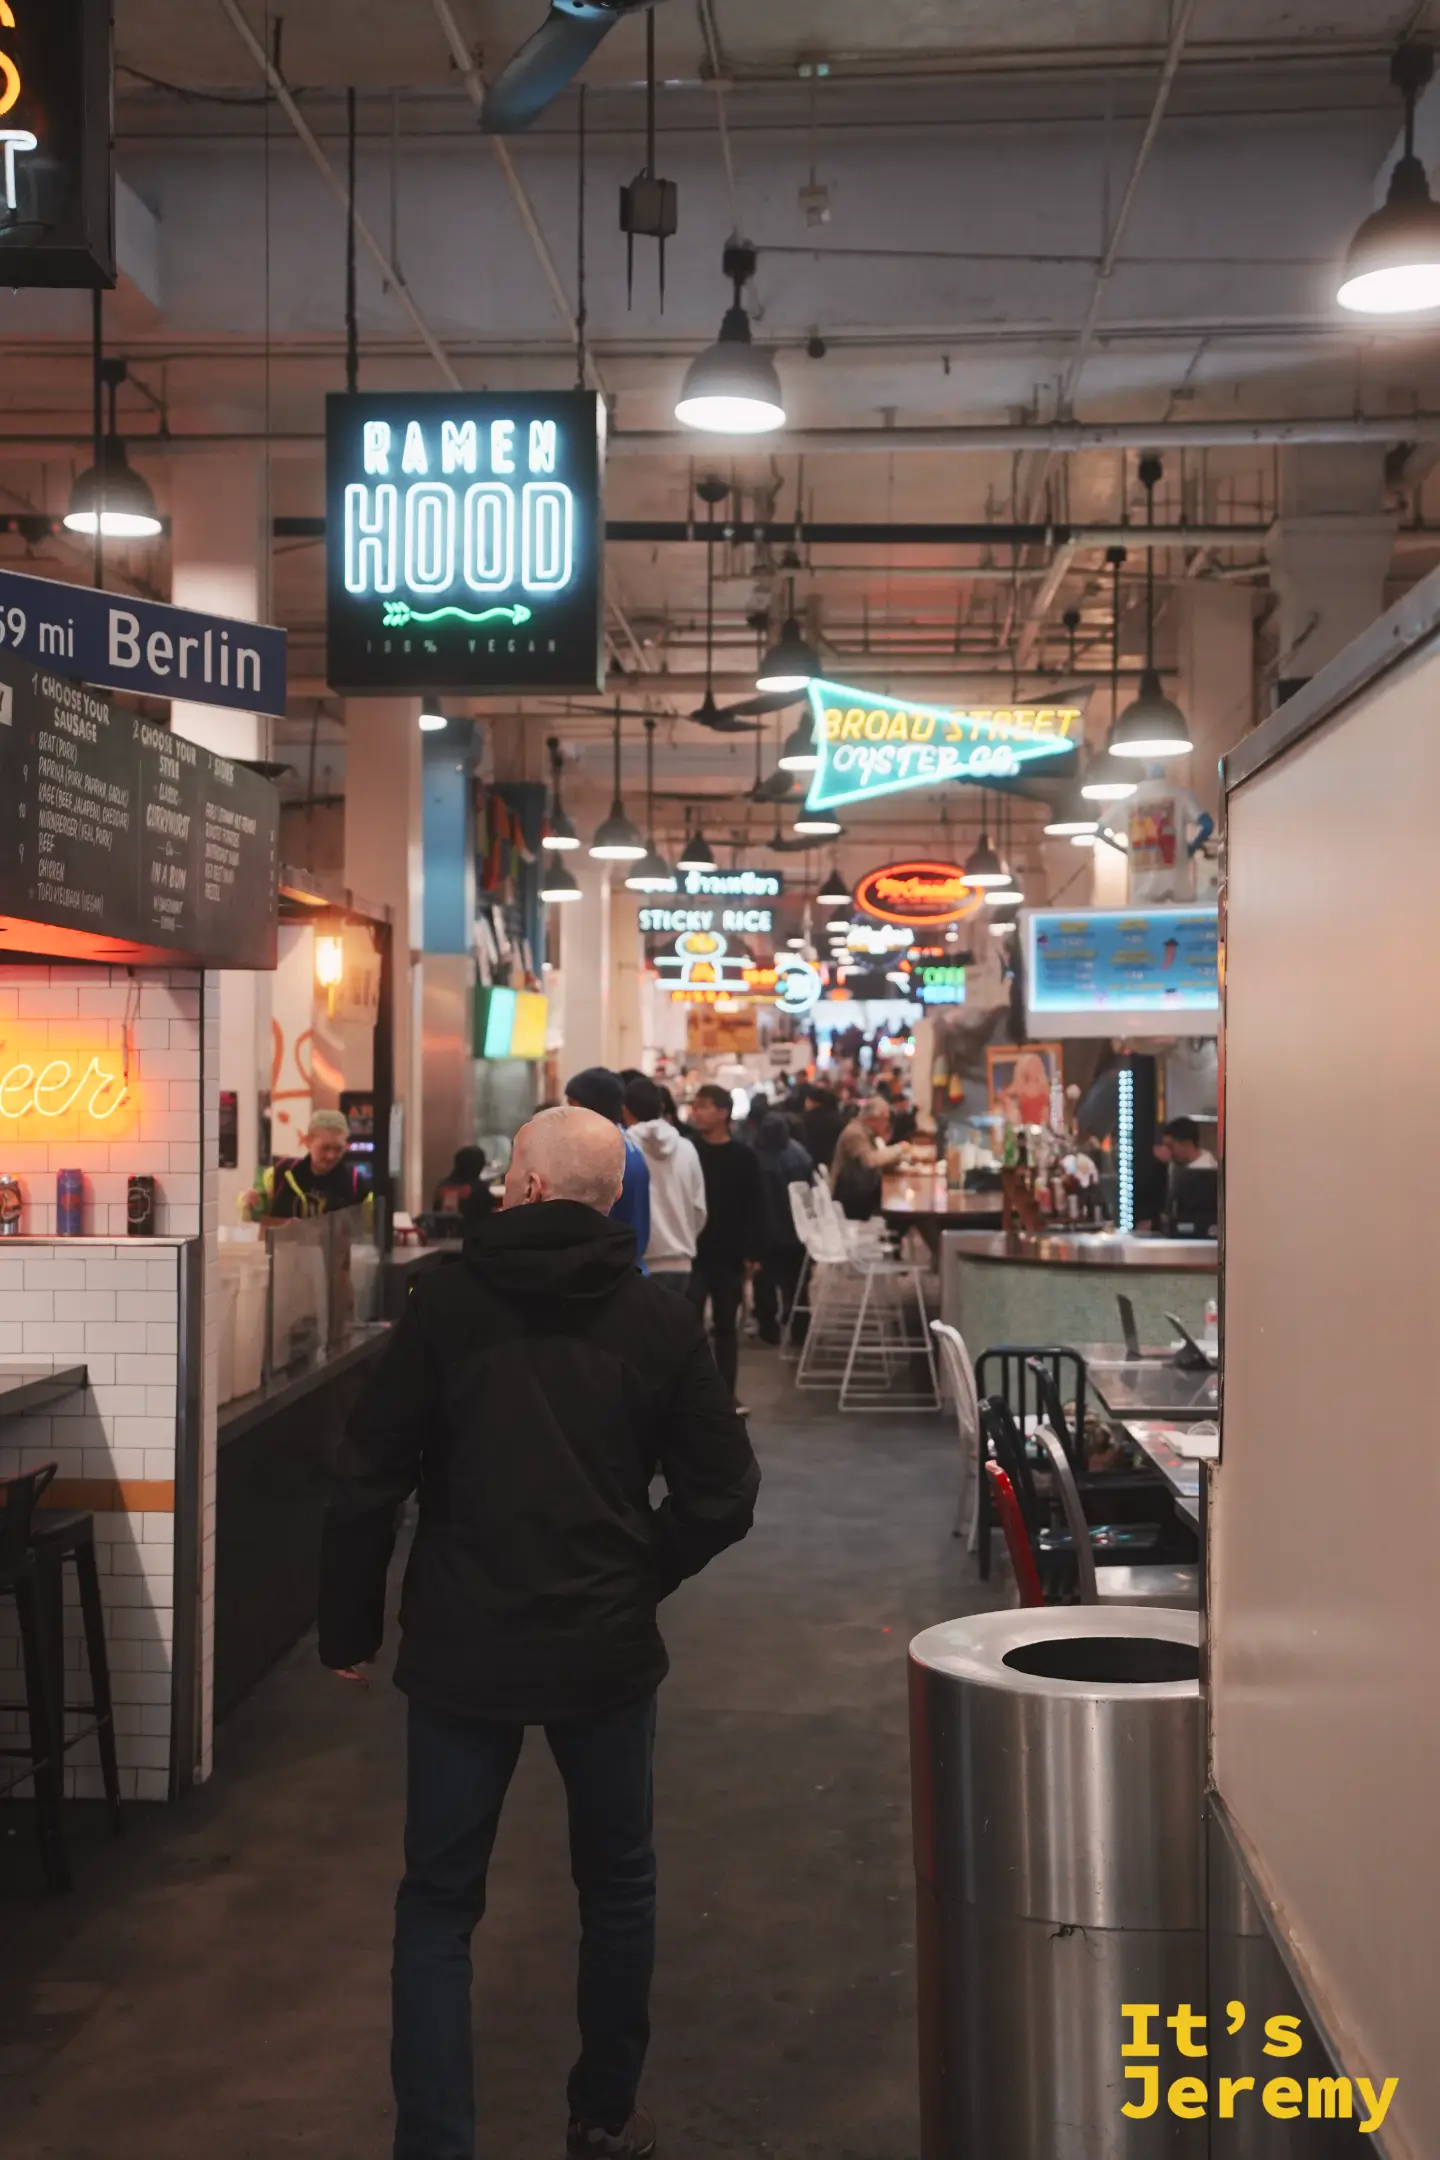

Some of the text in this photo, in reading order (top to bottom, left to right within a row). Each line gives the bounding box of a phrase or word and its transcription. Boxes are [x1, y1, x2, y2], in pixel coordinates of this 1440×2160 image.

[363, 419, 557, 475] RAMEN
[344, 482, 574, 593] HOOD
[39, 618, 74, 658] mi
[109, 608, 261, 692] Berlin
[468, 639, 556, 653] VEGAN
[42, 675, 82, 712] CHOOSE
[83, 693, 110, 725] YOUR
[54, 706, 97, 743] SAUSAGE
[141, 724, 173, 755] CHOOSE
[176, 739, 197, 766] YOUR
[825, 707, 1081, 743] BROAD STREET
[832, 744, 966, 786] OYSTER
[638, 908, 773, 932] STICKY RICE
